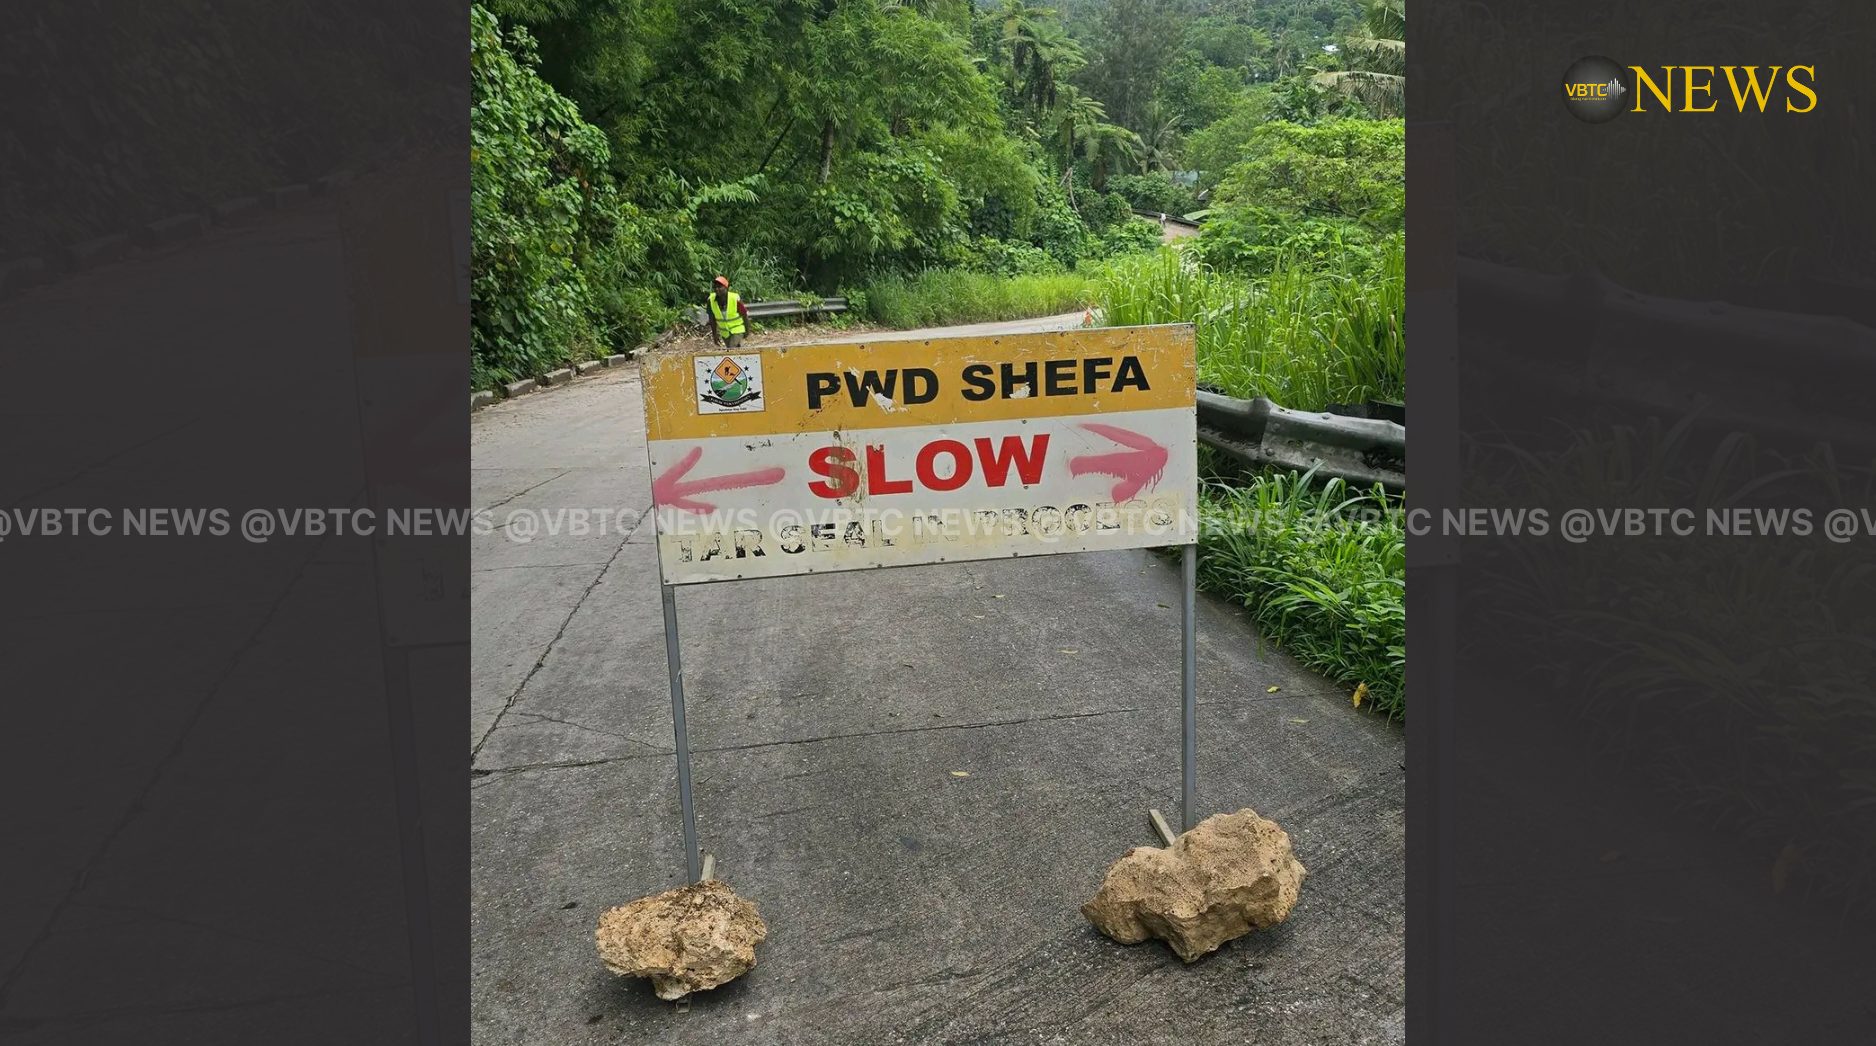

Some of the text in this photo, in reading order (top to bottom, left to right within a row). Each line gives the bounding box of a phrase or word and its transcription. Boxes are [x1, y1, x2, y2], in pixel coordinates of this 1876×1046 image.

[806, 356, 1151, 410] PWD SHEFA
[808, 433, 1051, 499] SLOW
[671, 529, 767, 563] TAR
[779, 519, 898, 555] SEAL
